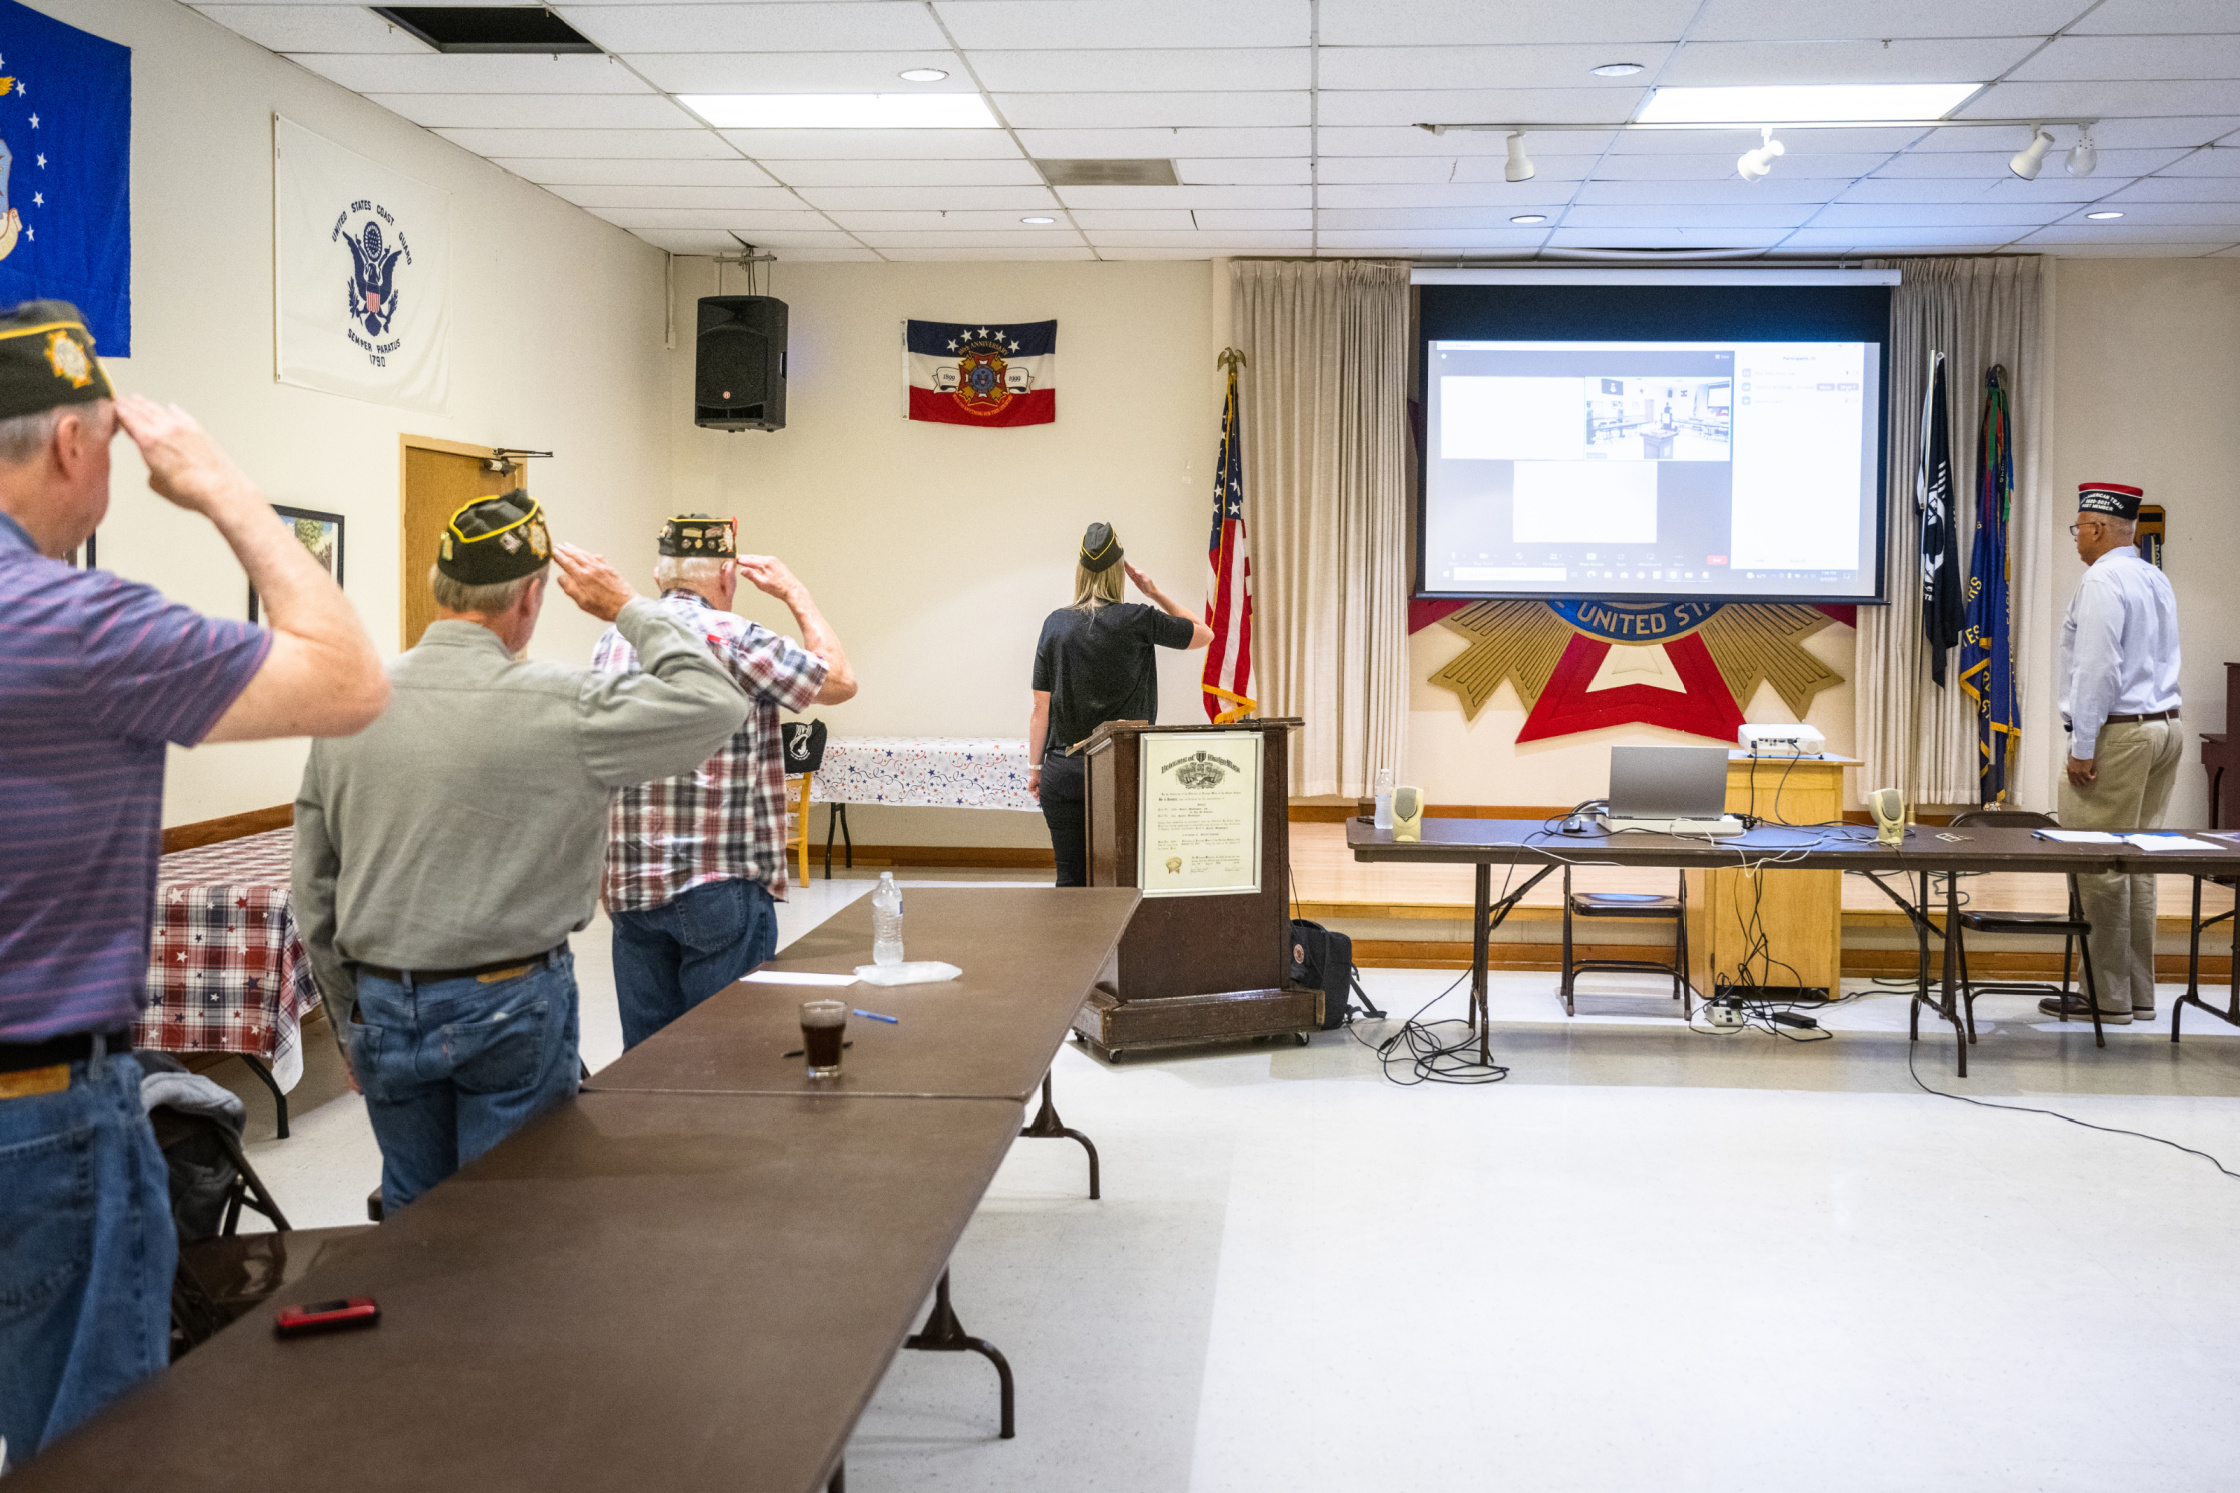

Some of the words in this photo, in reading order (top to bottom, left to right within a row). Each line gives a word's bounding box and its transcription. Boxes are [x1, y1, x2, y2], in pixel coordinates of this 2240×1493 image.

[331, 210, 347, 242] UNITED
[351, 200, 371, 213] STATES
[376, 204, 395, 226] COAST
[398, 231, 412, 265] GUARD
[347, 328, 372, 352] SEMPER
[376, 338, 401, 354] PARATUS
[970, 340, 1008, 356] ANNIVERSARY
[369, 354, 386, 367] 1790
[2087, 492, 2110, 500] AMERICAN
[2110, 497, 2124, 510] TEAM
[1576, 602, 1667, 635] UNITED
